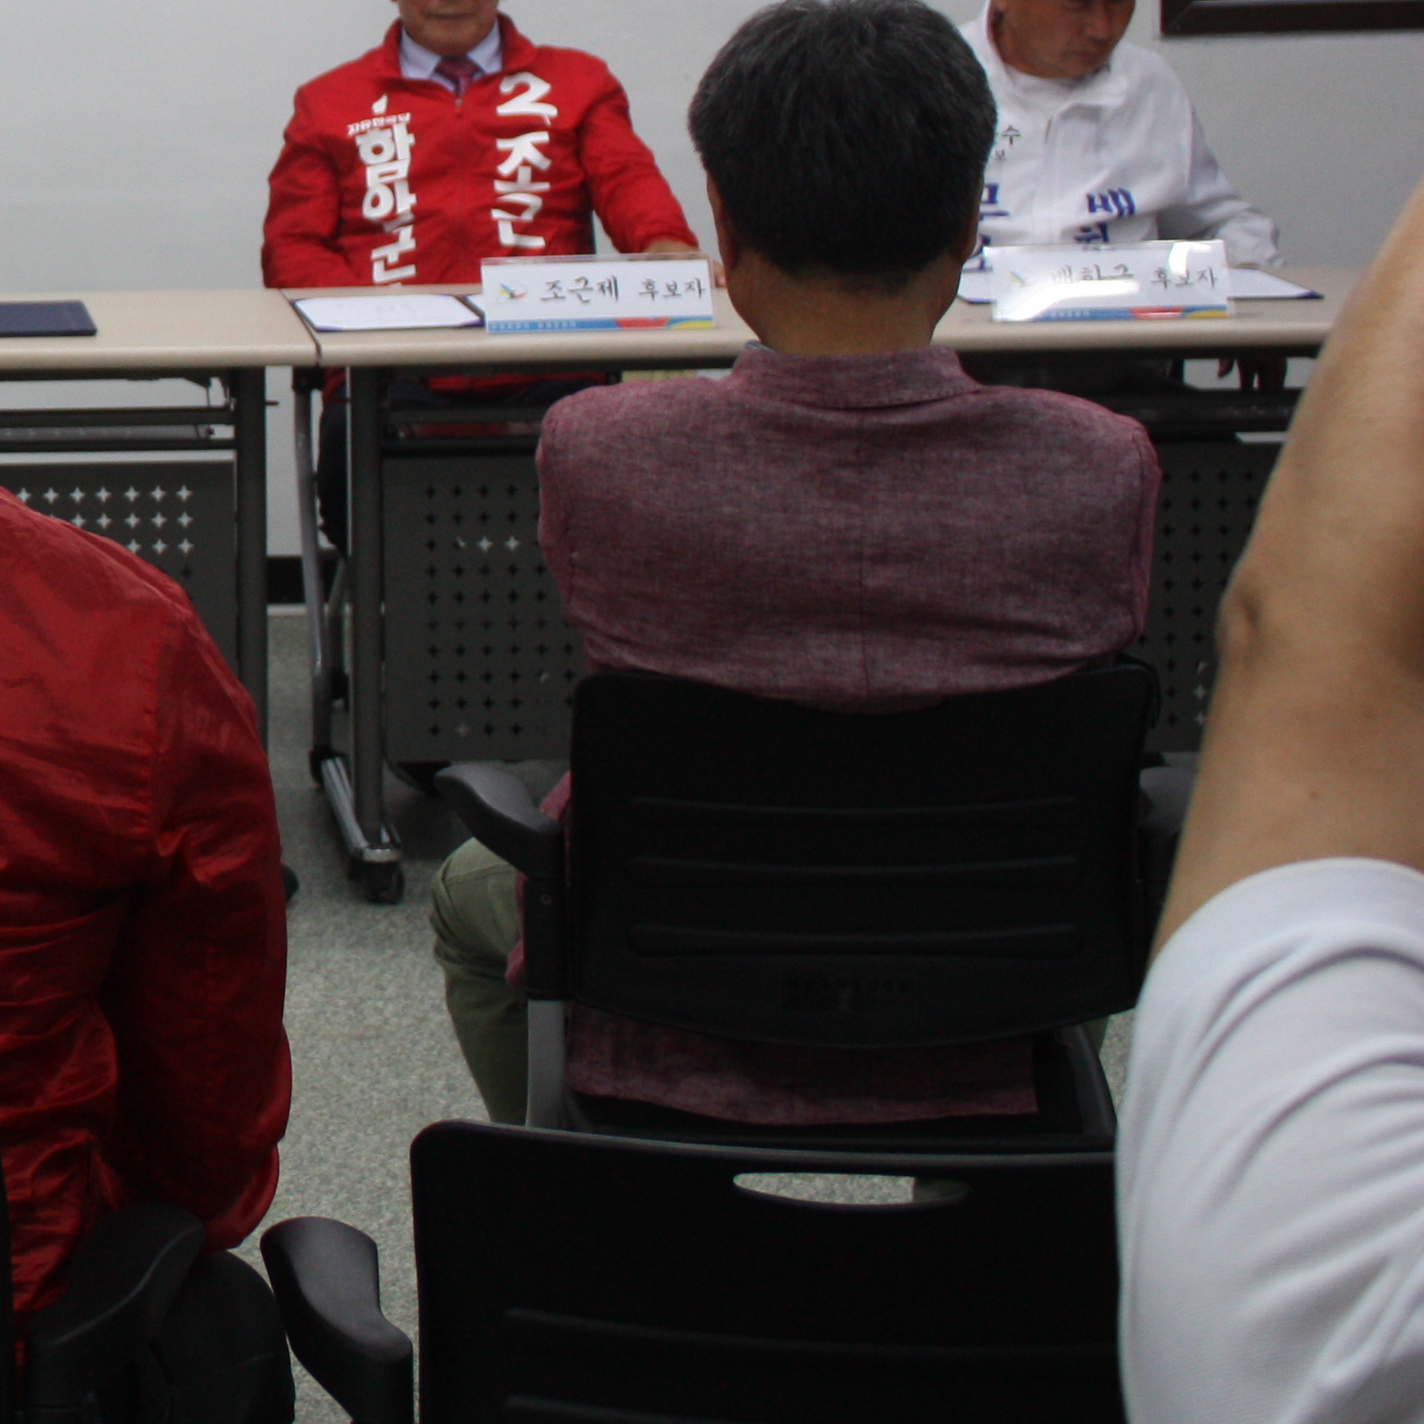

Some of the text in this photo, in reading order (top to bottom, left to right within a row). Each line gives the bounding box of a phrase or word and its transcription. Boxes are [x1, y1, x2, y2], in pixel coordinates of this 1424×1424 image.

[495, 71, 560, 119] 2
[540, 275, 707, 304] 조근제 후보자
